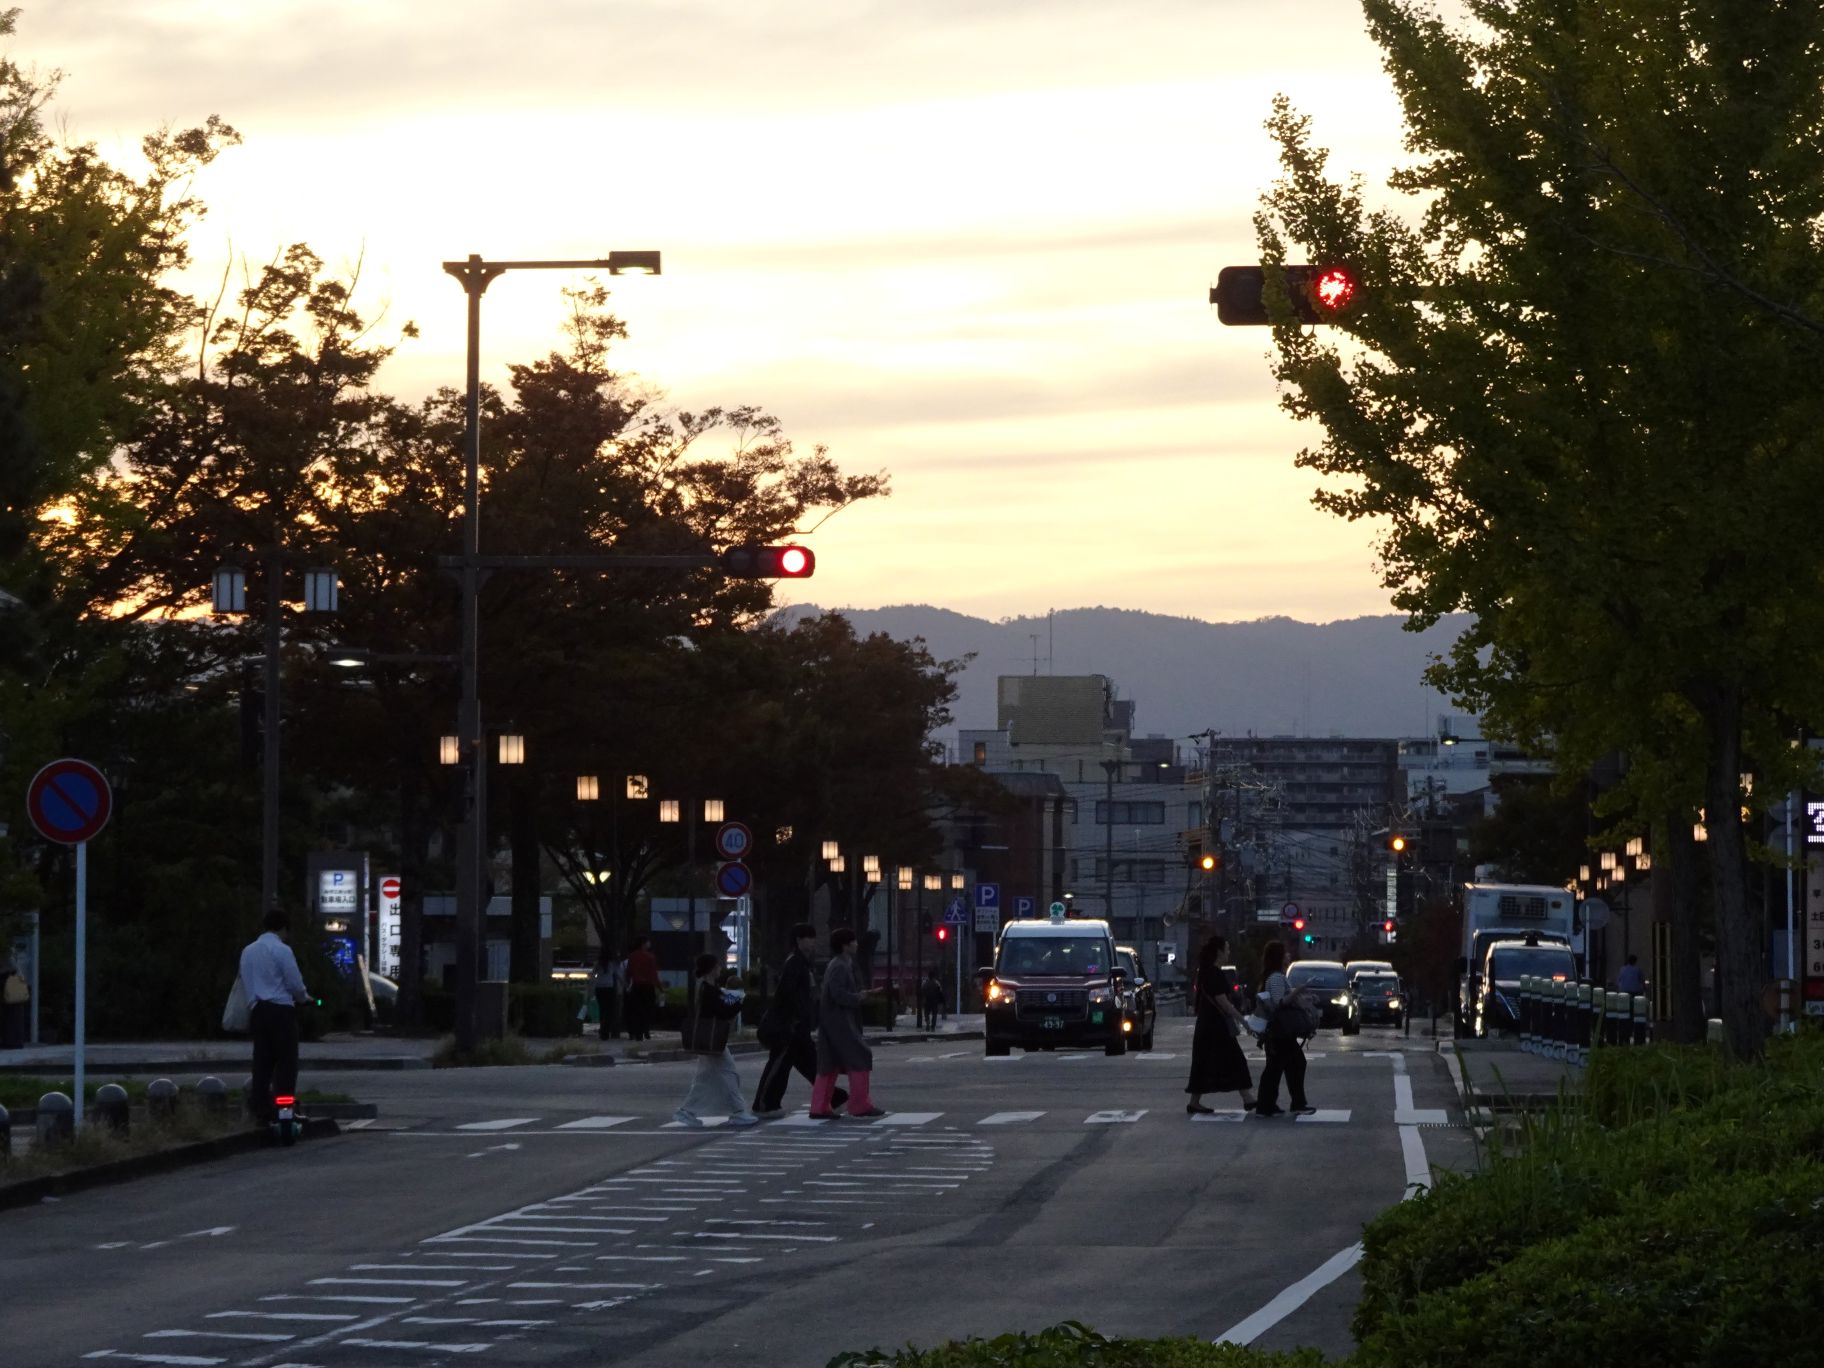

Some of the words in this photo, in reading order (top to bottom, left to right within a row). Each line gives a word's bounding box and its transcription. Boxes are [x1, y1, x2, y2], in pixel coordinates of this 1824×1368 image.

[725, 832, 743, 849] 40
[333, 872, 344, 886] P
[981, 886, 995, 905] P
[1018, 899, 1031, 916] P
